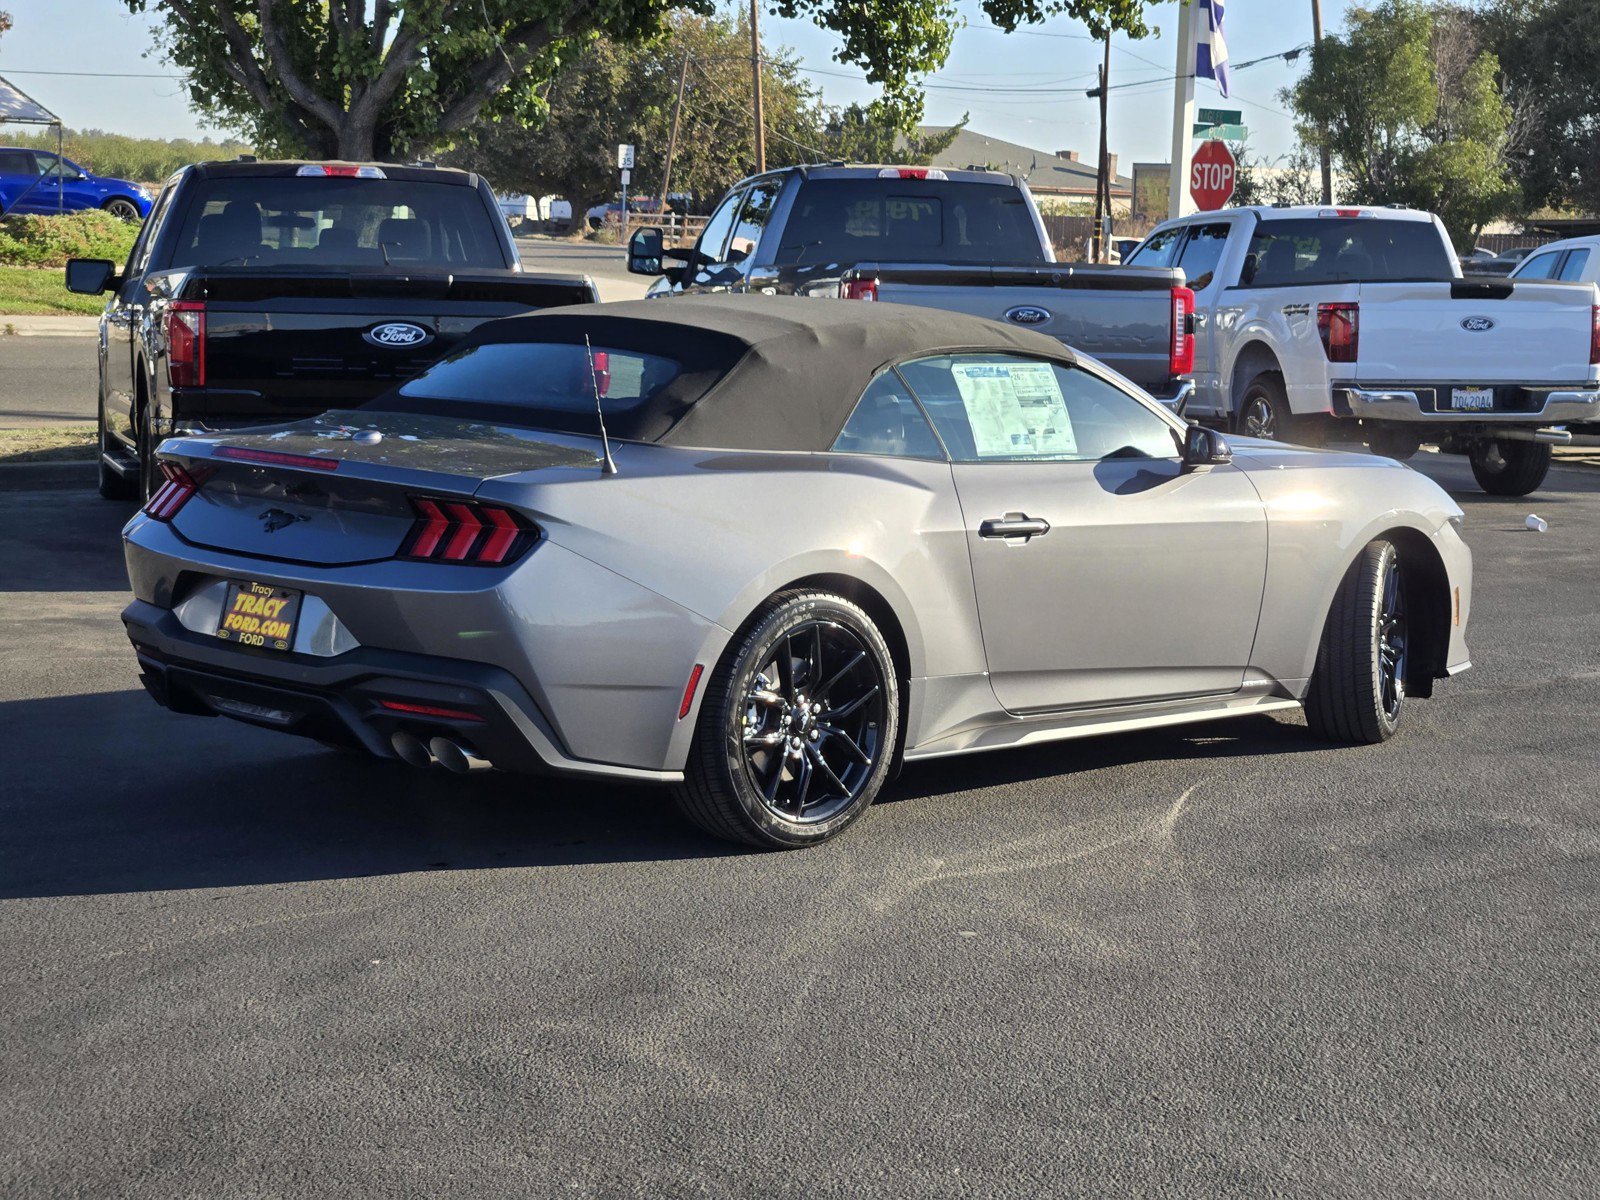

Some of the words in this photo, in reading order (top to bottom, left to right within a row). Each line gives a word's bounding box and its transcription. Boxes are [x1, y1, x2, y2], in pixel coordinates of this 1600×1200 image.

[1191, 163, 1232, 190] STOP
[1016, 310, 1041, 321] Ford
[1466, 318, 1489, 330] Ford
[380, 326, 416, 342] Ford
[251, 581, 275, 598] Tracy
[233, 592, 288, 617] TRACY
[223, 613, 291, 639] FORD.COM
[238, 632, 264, 646] FORD
